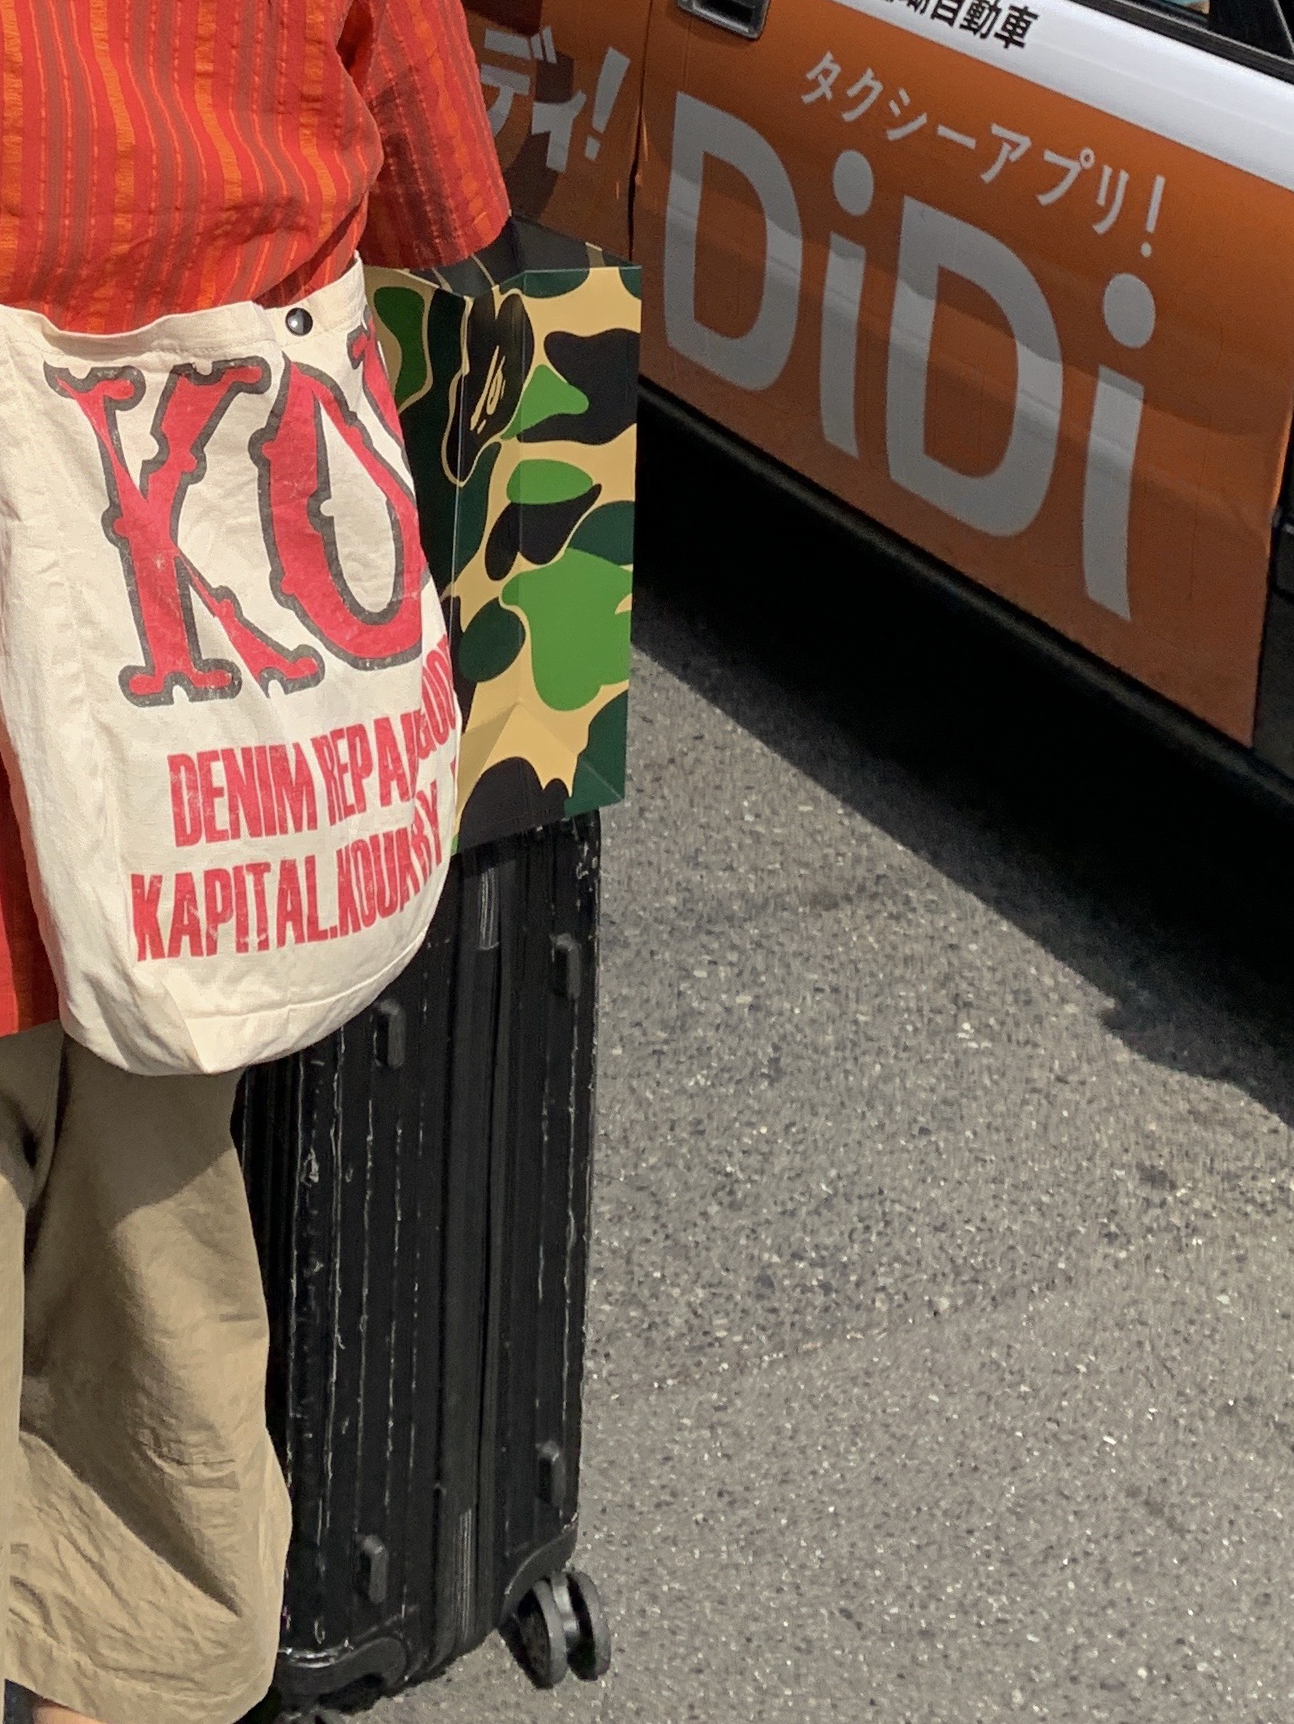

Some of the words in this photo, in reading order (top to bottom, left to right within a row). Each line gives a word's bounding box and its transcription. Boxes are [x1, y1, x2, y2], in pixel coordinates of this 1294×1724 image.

[801, 50, 1166, 258] タクシーアプリ!
[43, 306, 432, 708] KO
[663, 90, 1157, 622] DiDi
[167, 740, 318, 848] DENIM
[310, 708, 421, 827] REPAI
